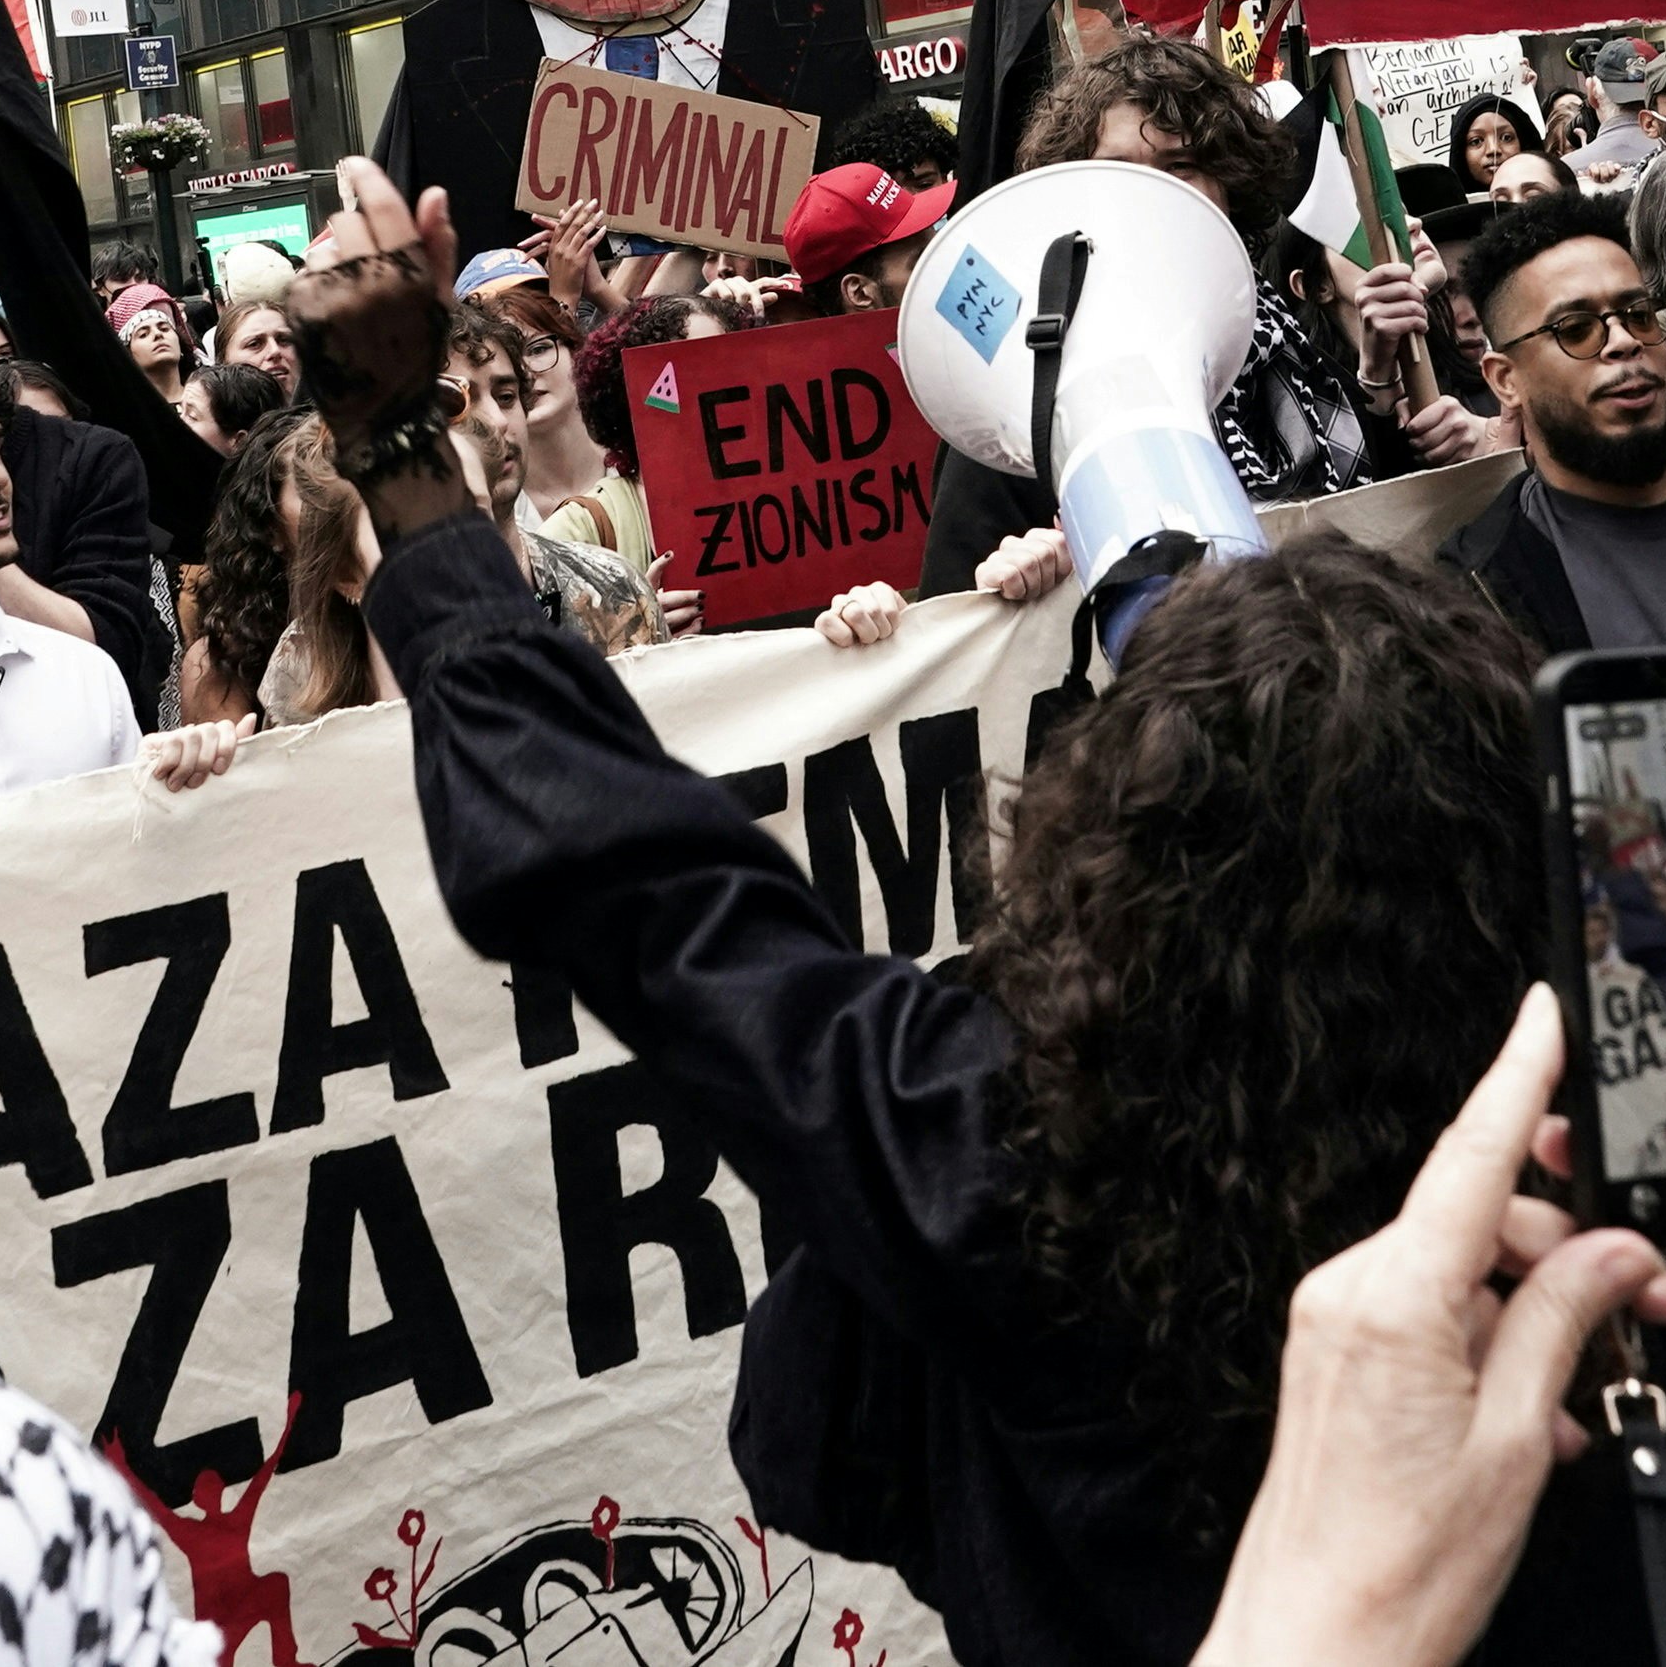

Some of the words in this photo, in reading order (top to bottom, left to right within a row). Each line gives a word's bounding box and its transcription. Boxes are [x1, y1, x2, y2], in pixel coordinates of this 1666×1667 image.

[89, 10, 110, 23] JLL
[879, 37, 958, 84] ARGO
[1364, 41, 1466, 73] Benjamin
[1387, 98, 1409, 116] an
[527, 81, 789, 245] CRIMINAL
[957, 277, 988, 320] PYN
[975, 296, 1005, 337] NYC
[698, 367, 892, 480] END
[693, 461, 932, 577] ZIONISM
